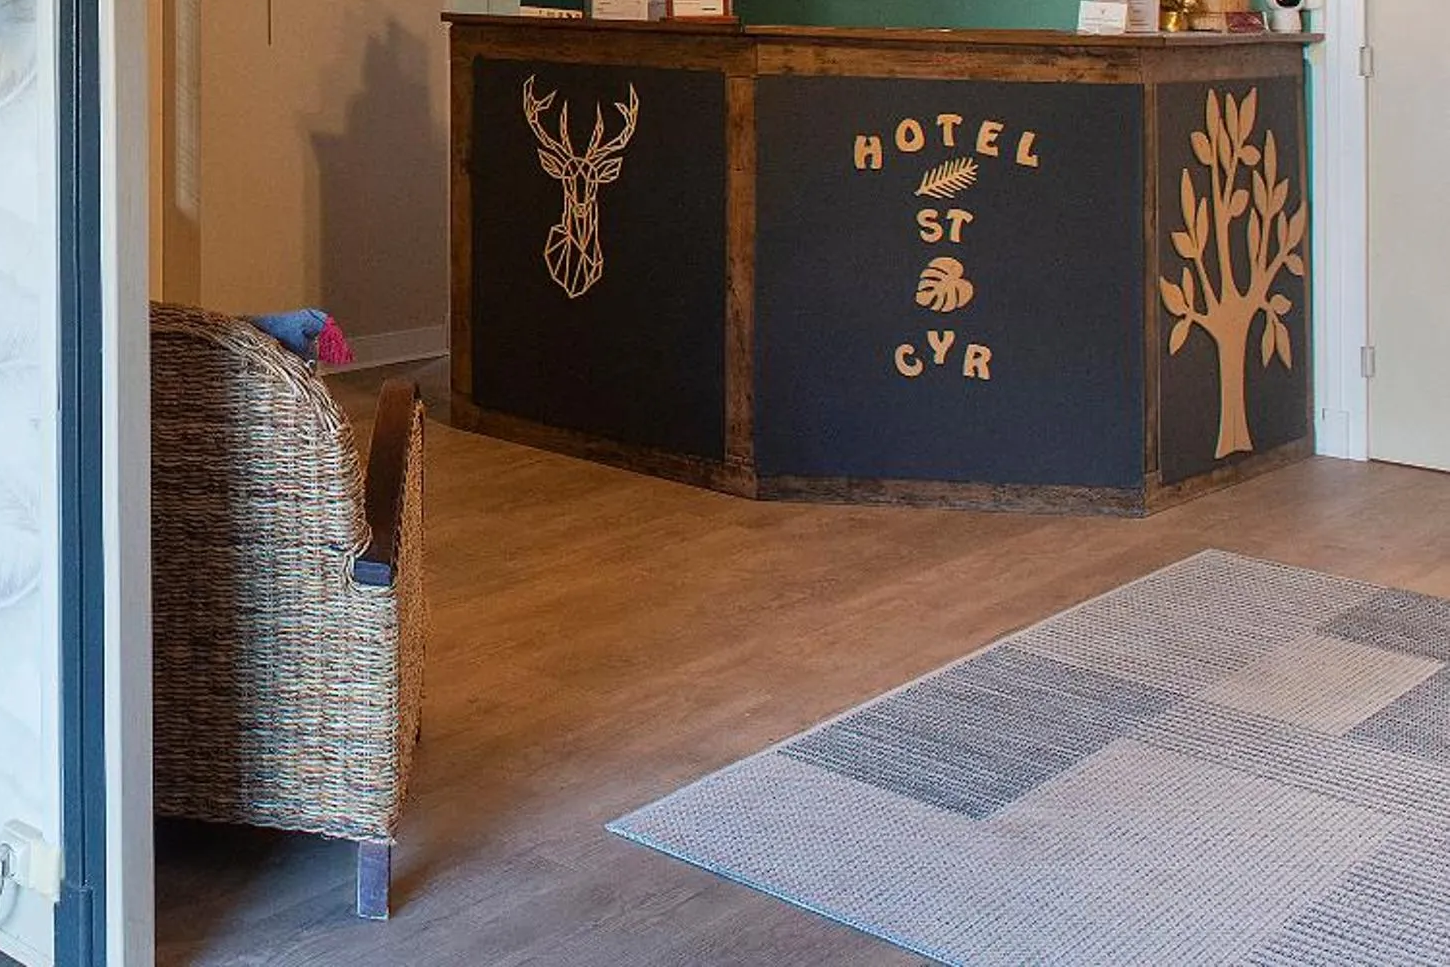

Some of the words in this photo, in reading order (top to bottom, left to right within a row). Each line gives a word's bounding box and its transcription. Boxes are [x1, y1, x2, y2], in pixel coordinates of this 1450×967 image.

[853, 113, 1039, 170] HOTEL
[916, 208, 974, 243] ST
[894, 330, 993, 381] CYR
